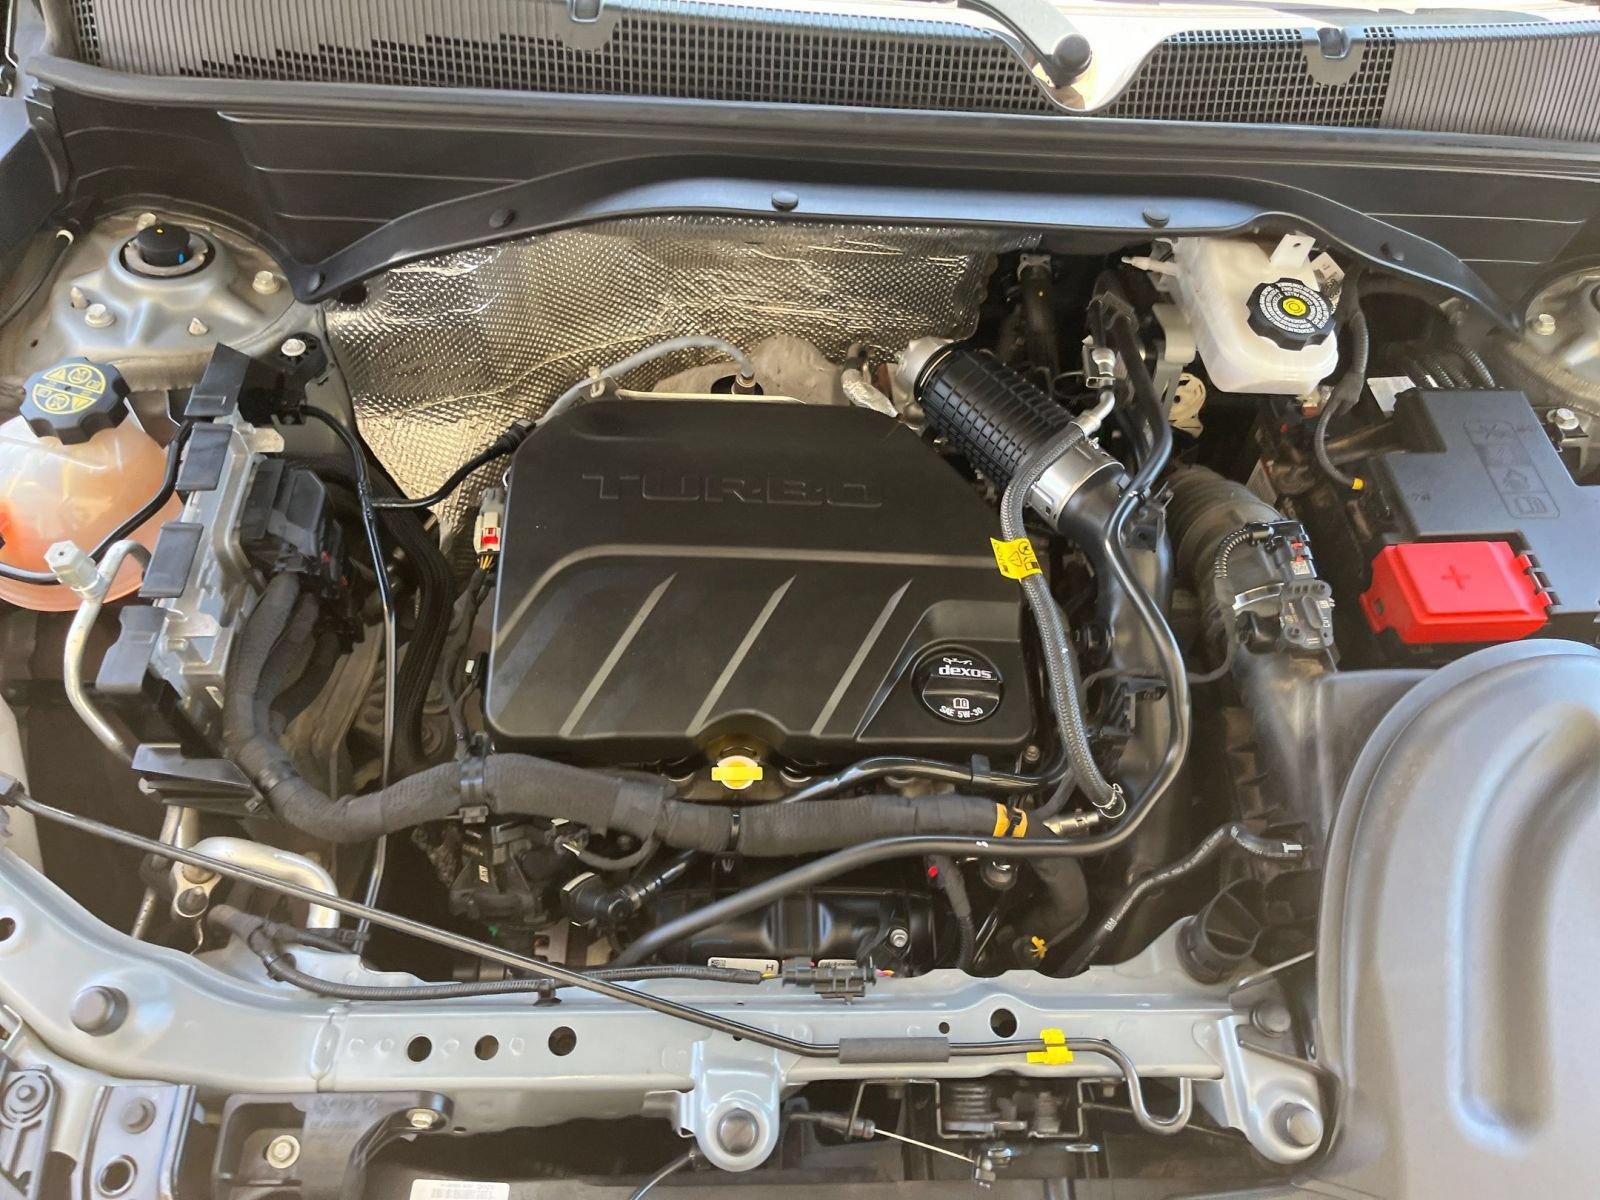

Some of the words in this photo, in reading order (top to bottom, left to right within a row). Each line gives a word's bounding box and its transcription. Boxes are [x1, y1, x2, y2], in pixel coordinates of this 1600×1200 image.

[581, 474, 883, 508] TURBO
[938, 664, 993, 679] dexos
[939, 705, 956, 717] SAE
[957, 706, 984, 718] 5W-30
[765, 963, 775, 972] H
